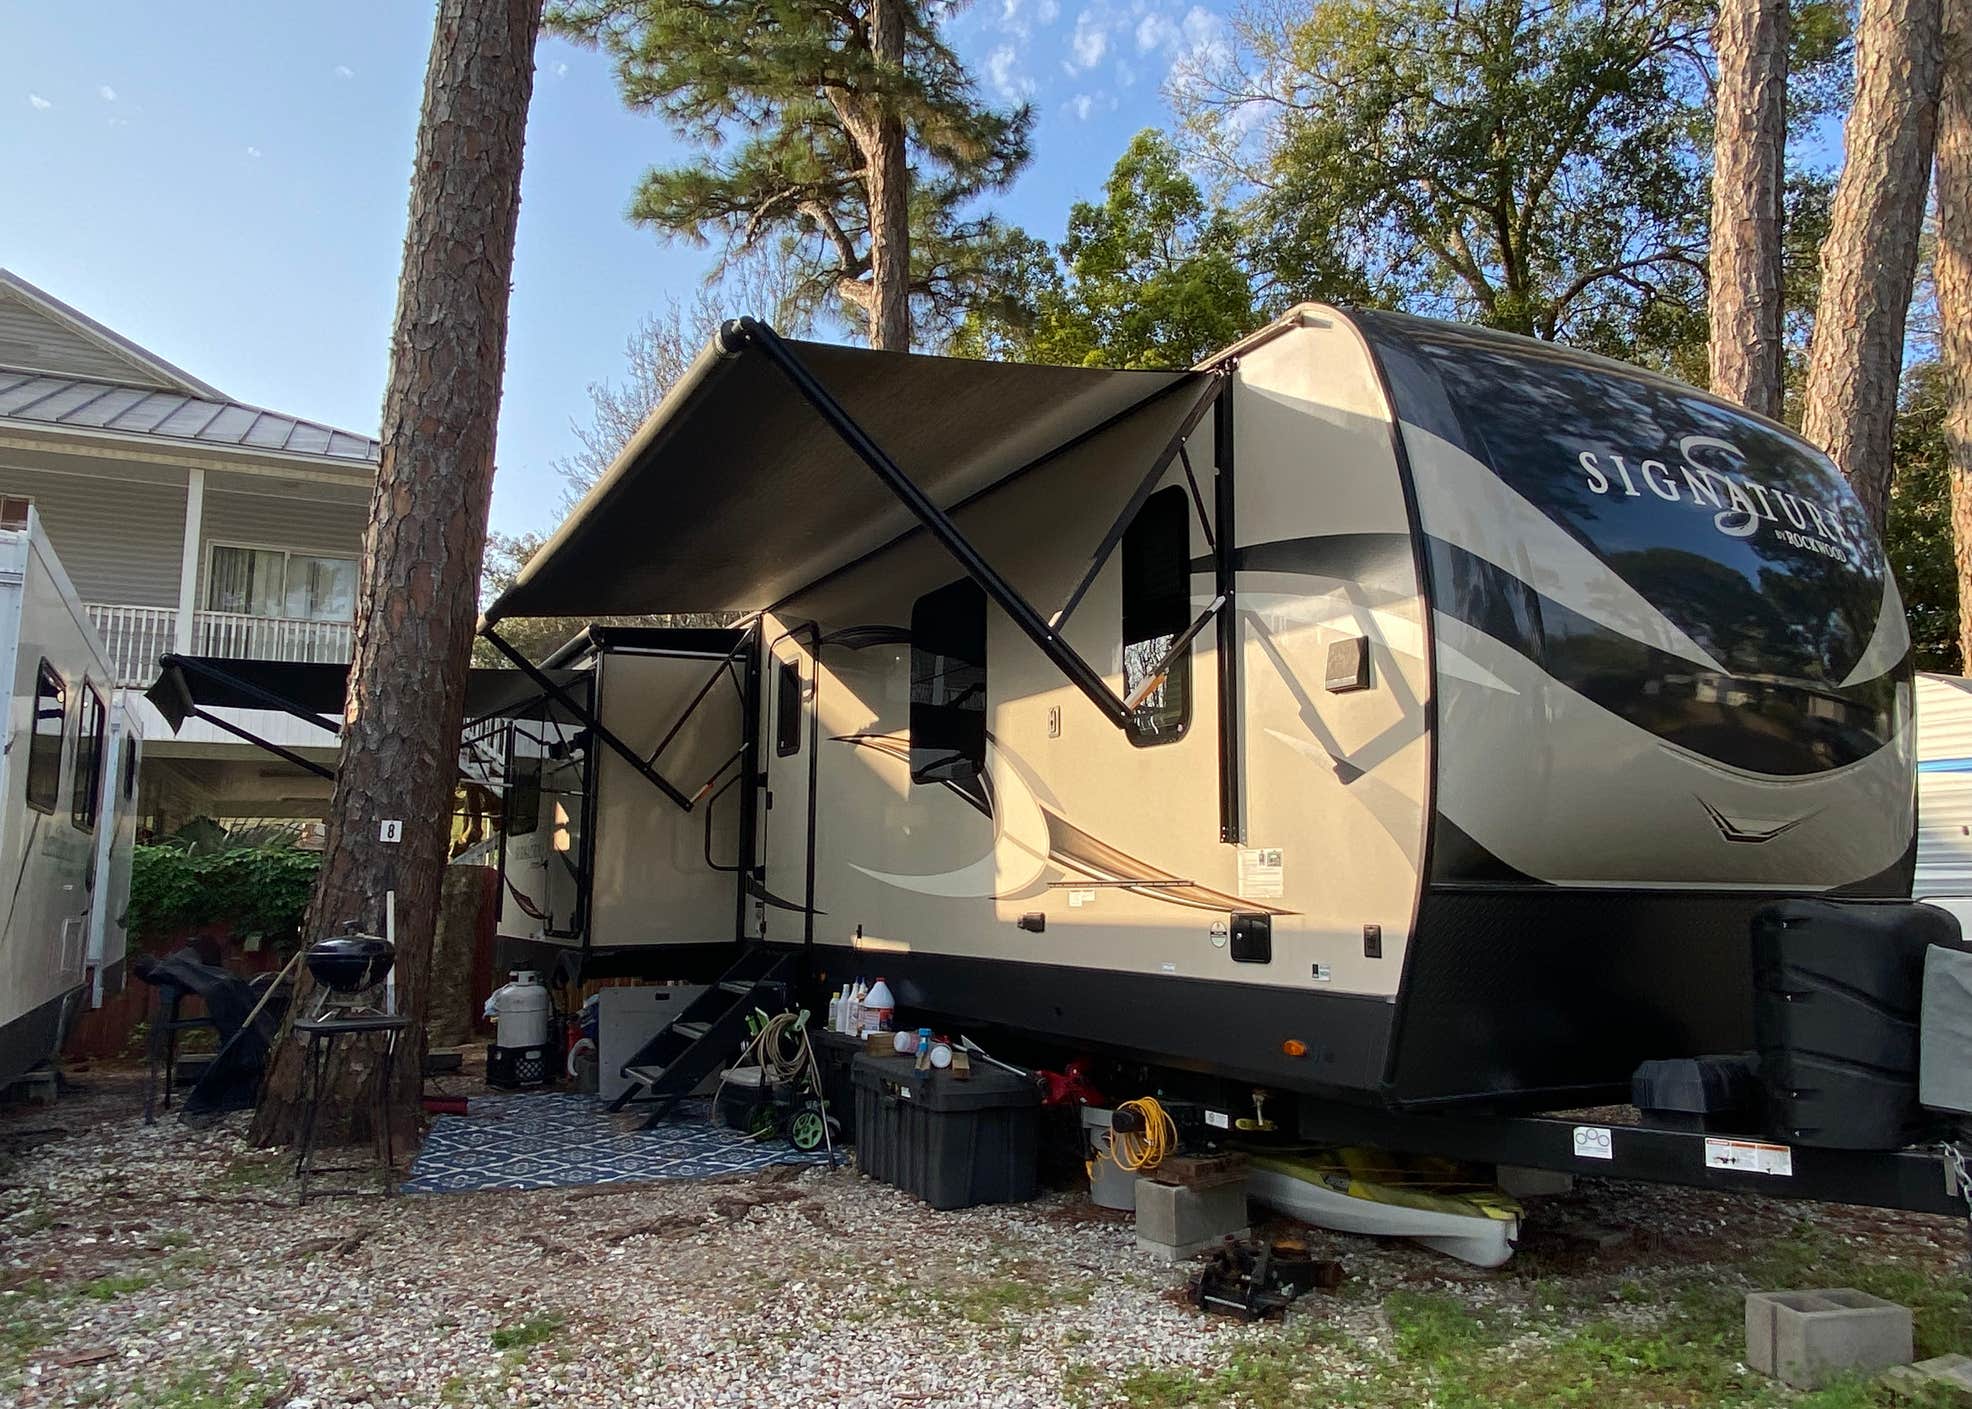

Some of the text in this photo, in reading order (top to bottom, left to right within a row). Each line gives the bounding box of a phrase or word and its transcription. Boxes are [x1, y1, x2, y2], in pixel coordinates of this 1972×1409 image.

[1578, 451, 1850, 546] SIGNATURE
[1784, 530, 1847, 562] ROCKWOOD
[387, 823, 395, 838] 8
